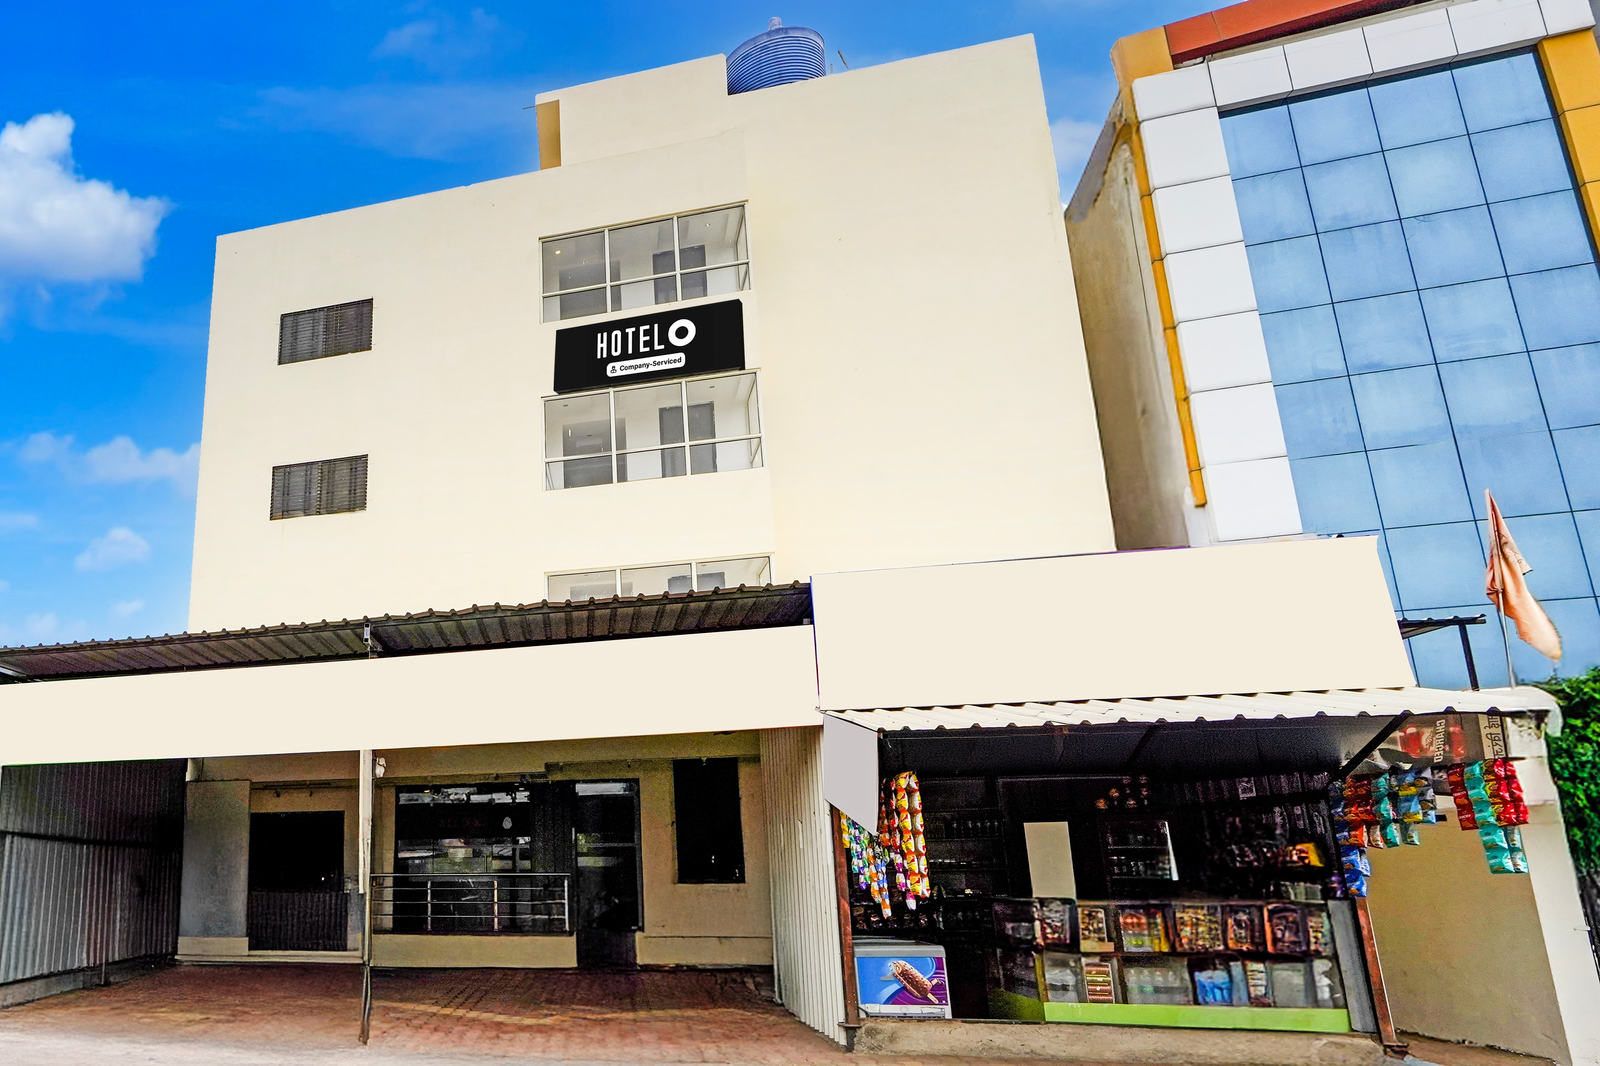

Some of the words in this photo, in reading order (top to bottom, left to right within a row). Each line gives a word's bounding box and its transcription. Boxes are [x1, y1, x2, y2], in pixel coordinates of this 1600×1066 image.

[597, 323, 665, 359] HOTEL
[668, 318, 697, 347] O
[619, 356, 682, 372] Company-Serviced
